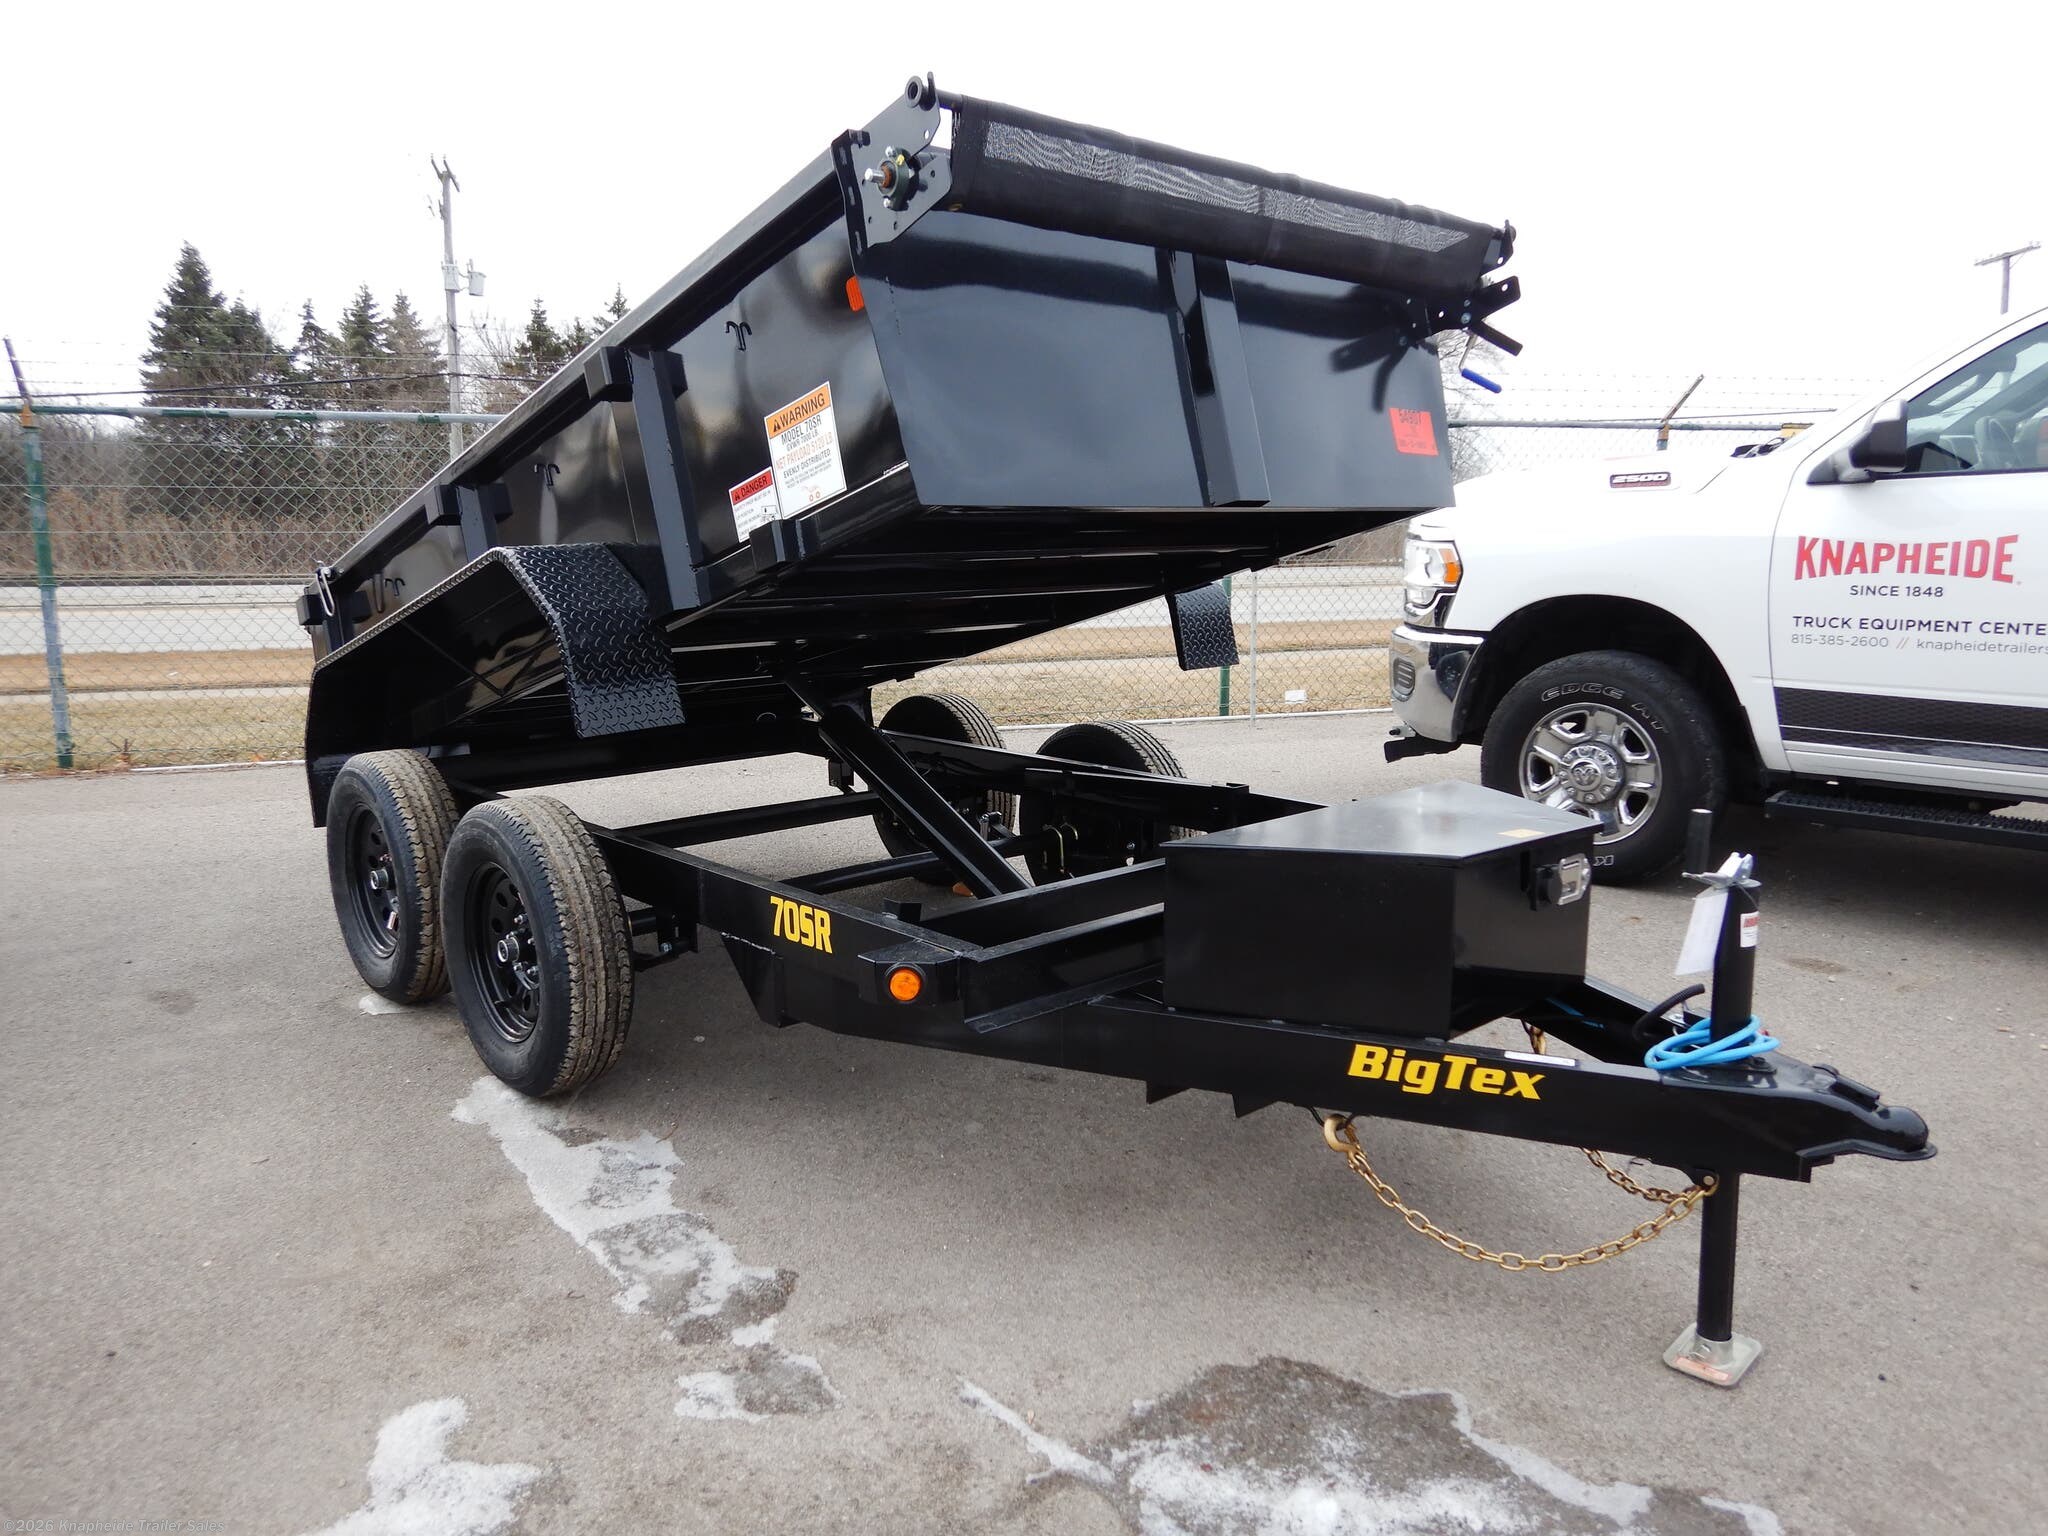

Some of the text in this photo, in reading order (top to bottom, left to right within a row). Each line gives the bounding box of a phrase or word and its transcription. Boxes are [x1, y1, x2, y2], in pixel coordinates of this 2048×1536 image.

[780, 393, 825, 427] WARNING
[781, 415, 822, 445] MODEL 70SR
[787, 443, 811, 465] PAYLOAD
[741, 476, 768, 497] DANGER
[1795, 534, 2019, 583] KNAPHEIDE
[1849, 585, 1944, 598] SINCE 1848
[1792, 616, 1852, 629] TRUCK
[1859, 618, 1972, 634] EQUIPMENT
[1791, 634, 1889, 648] 815-385-2600
[1541, 682, 1626, 702] EDGE
[770, 895, 833, 954] 70SR
[1347, 1043, 1545, 1100] BigTex
